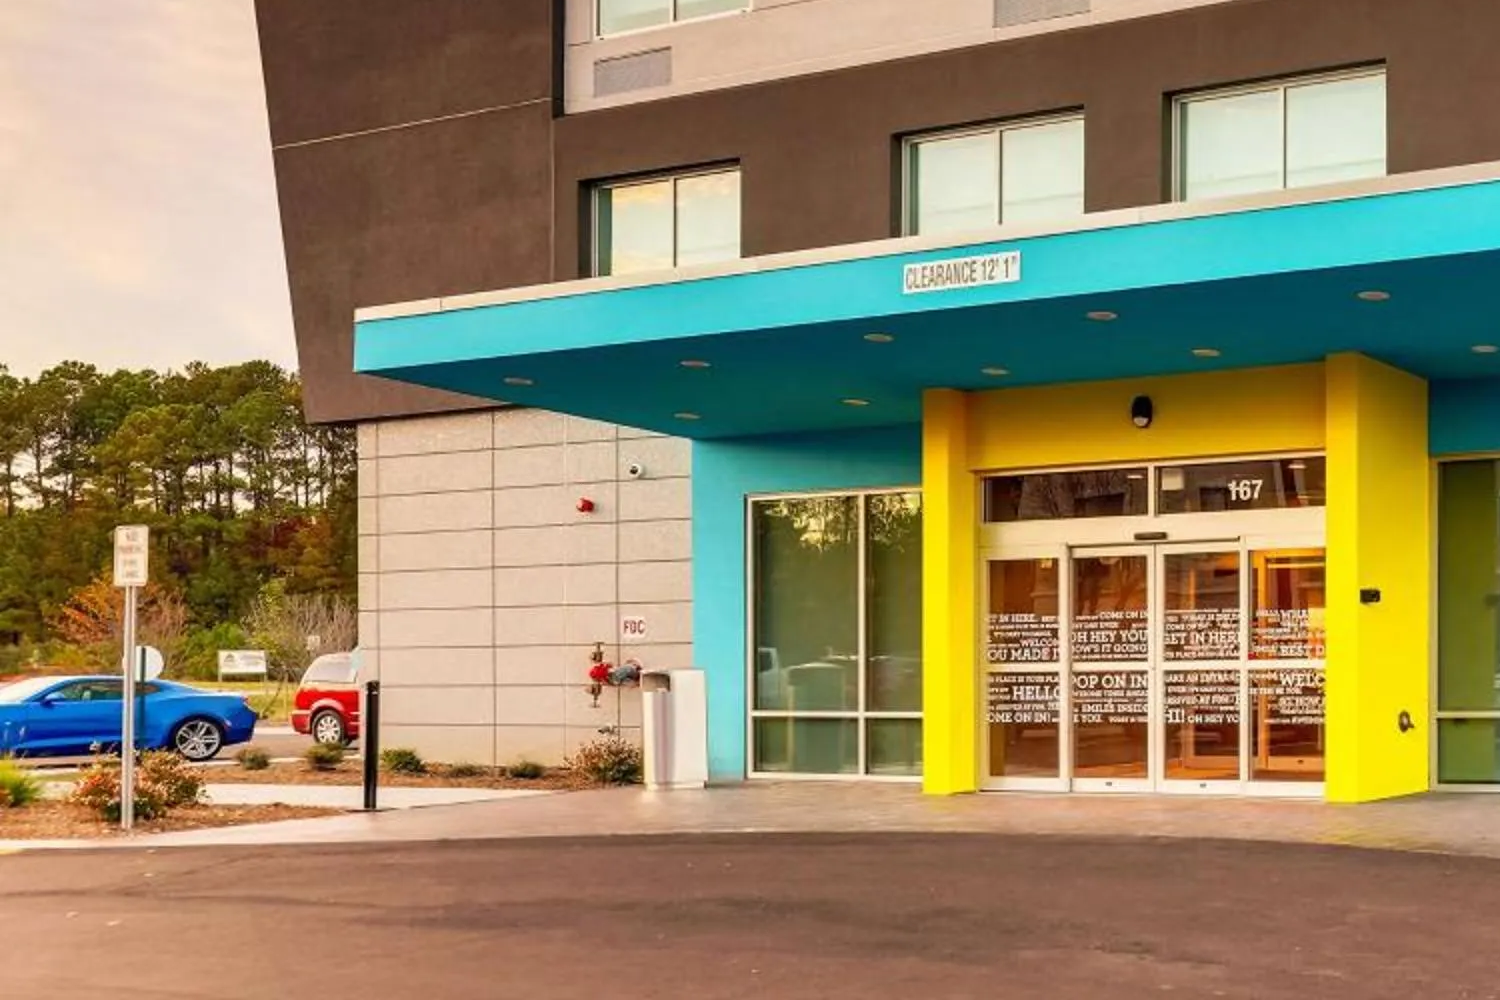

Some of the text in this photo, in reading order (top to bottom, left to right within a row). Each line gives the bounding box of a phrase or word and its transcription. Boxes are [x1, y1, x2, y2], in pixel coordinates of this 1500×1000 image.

[905, 261, 977, 290] CLEARANCE
[982, 257, 999, 281] 12'
[1228, 479, 1263, 501] 167
[623, 619, 646, 634] FDC
[1090, 630, 1116, 643] HEY
[1120, 630, 1148, 642] YOU
[1208, 632, 1240, 644] HER
[988, 649, 1008, 661] OU
[1102, 674, 1127, 689] ON
[1280, 672, 1325, 687] WELC
[987, 712, 1013, 723] OME
